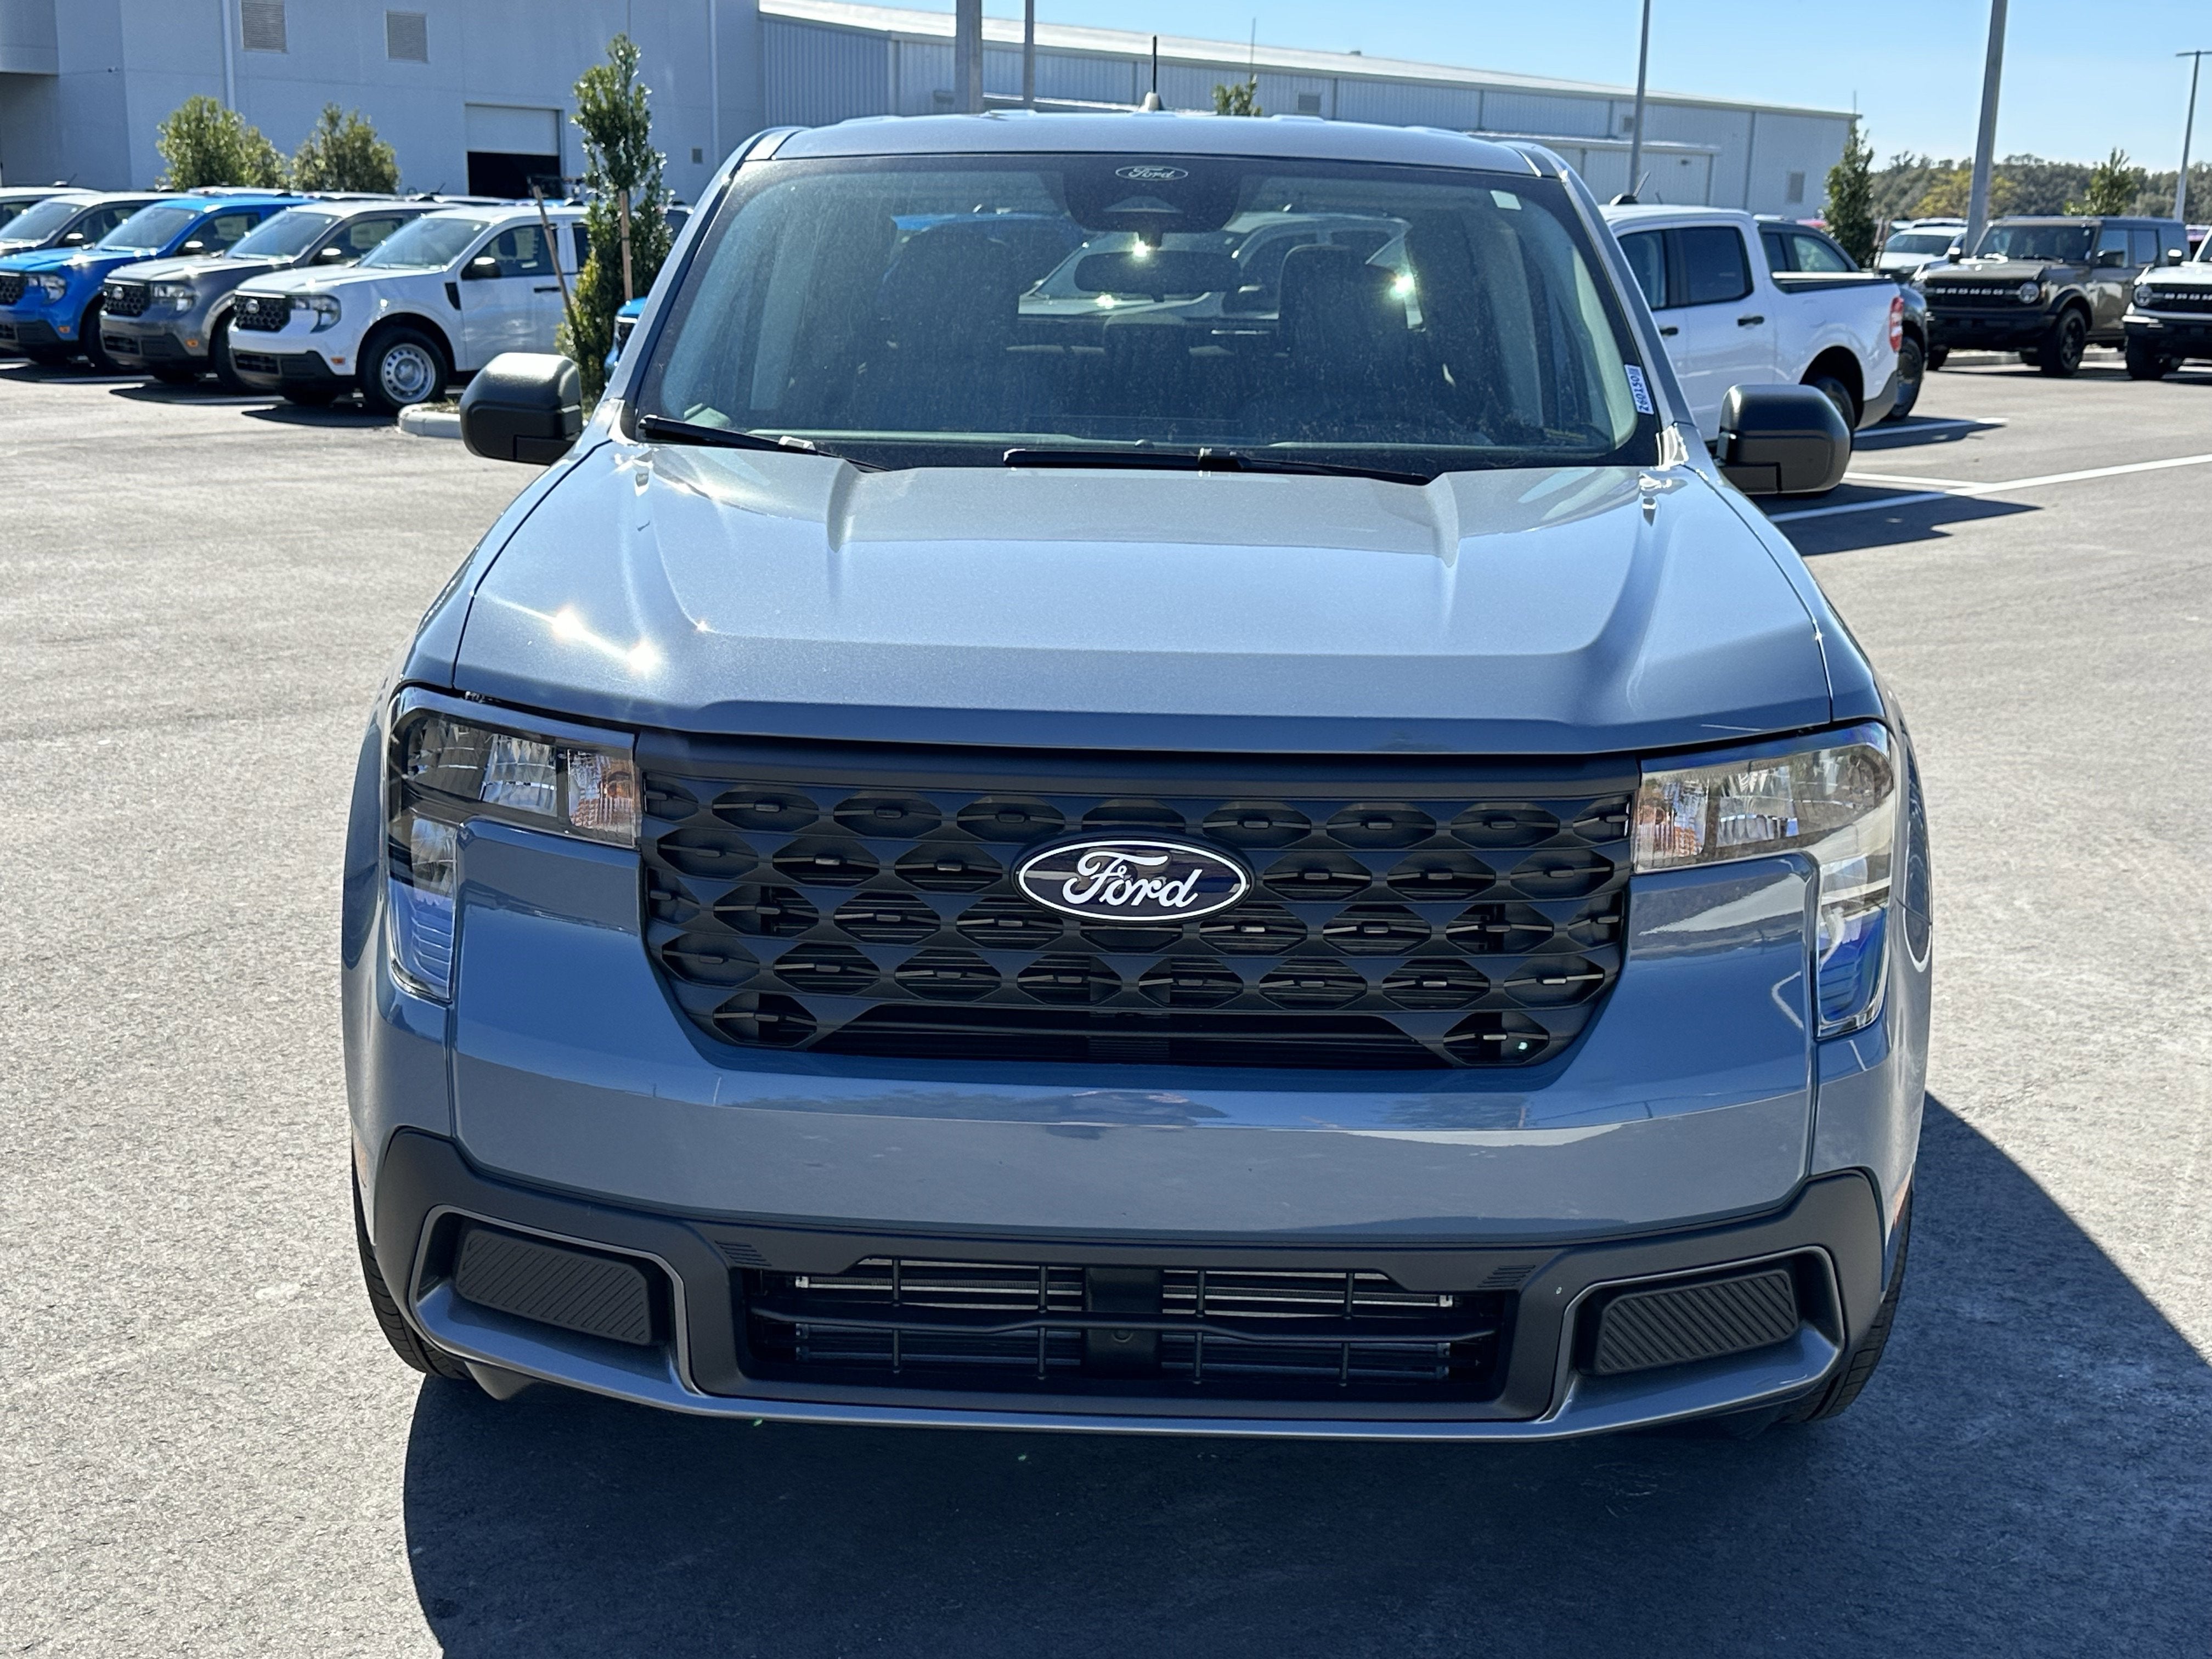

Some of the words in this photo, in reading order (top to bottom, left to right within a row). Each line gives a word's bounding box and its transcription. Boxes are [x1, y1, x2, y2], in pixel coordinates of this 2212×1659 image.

[1128, 167, 1175, 179] Ford
[1630, 376, 1649, 411] 260150
[1062, 851, 1203, 908] Ford
